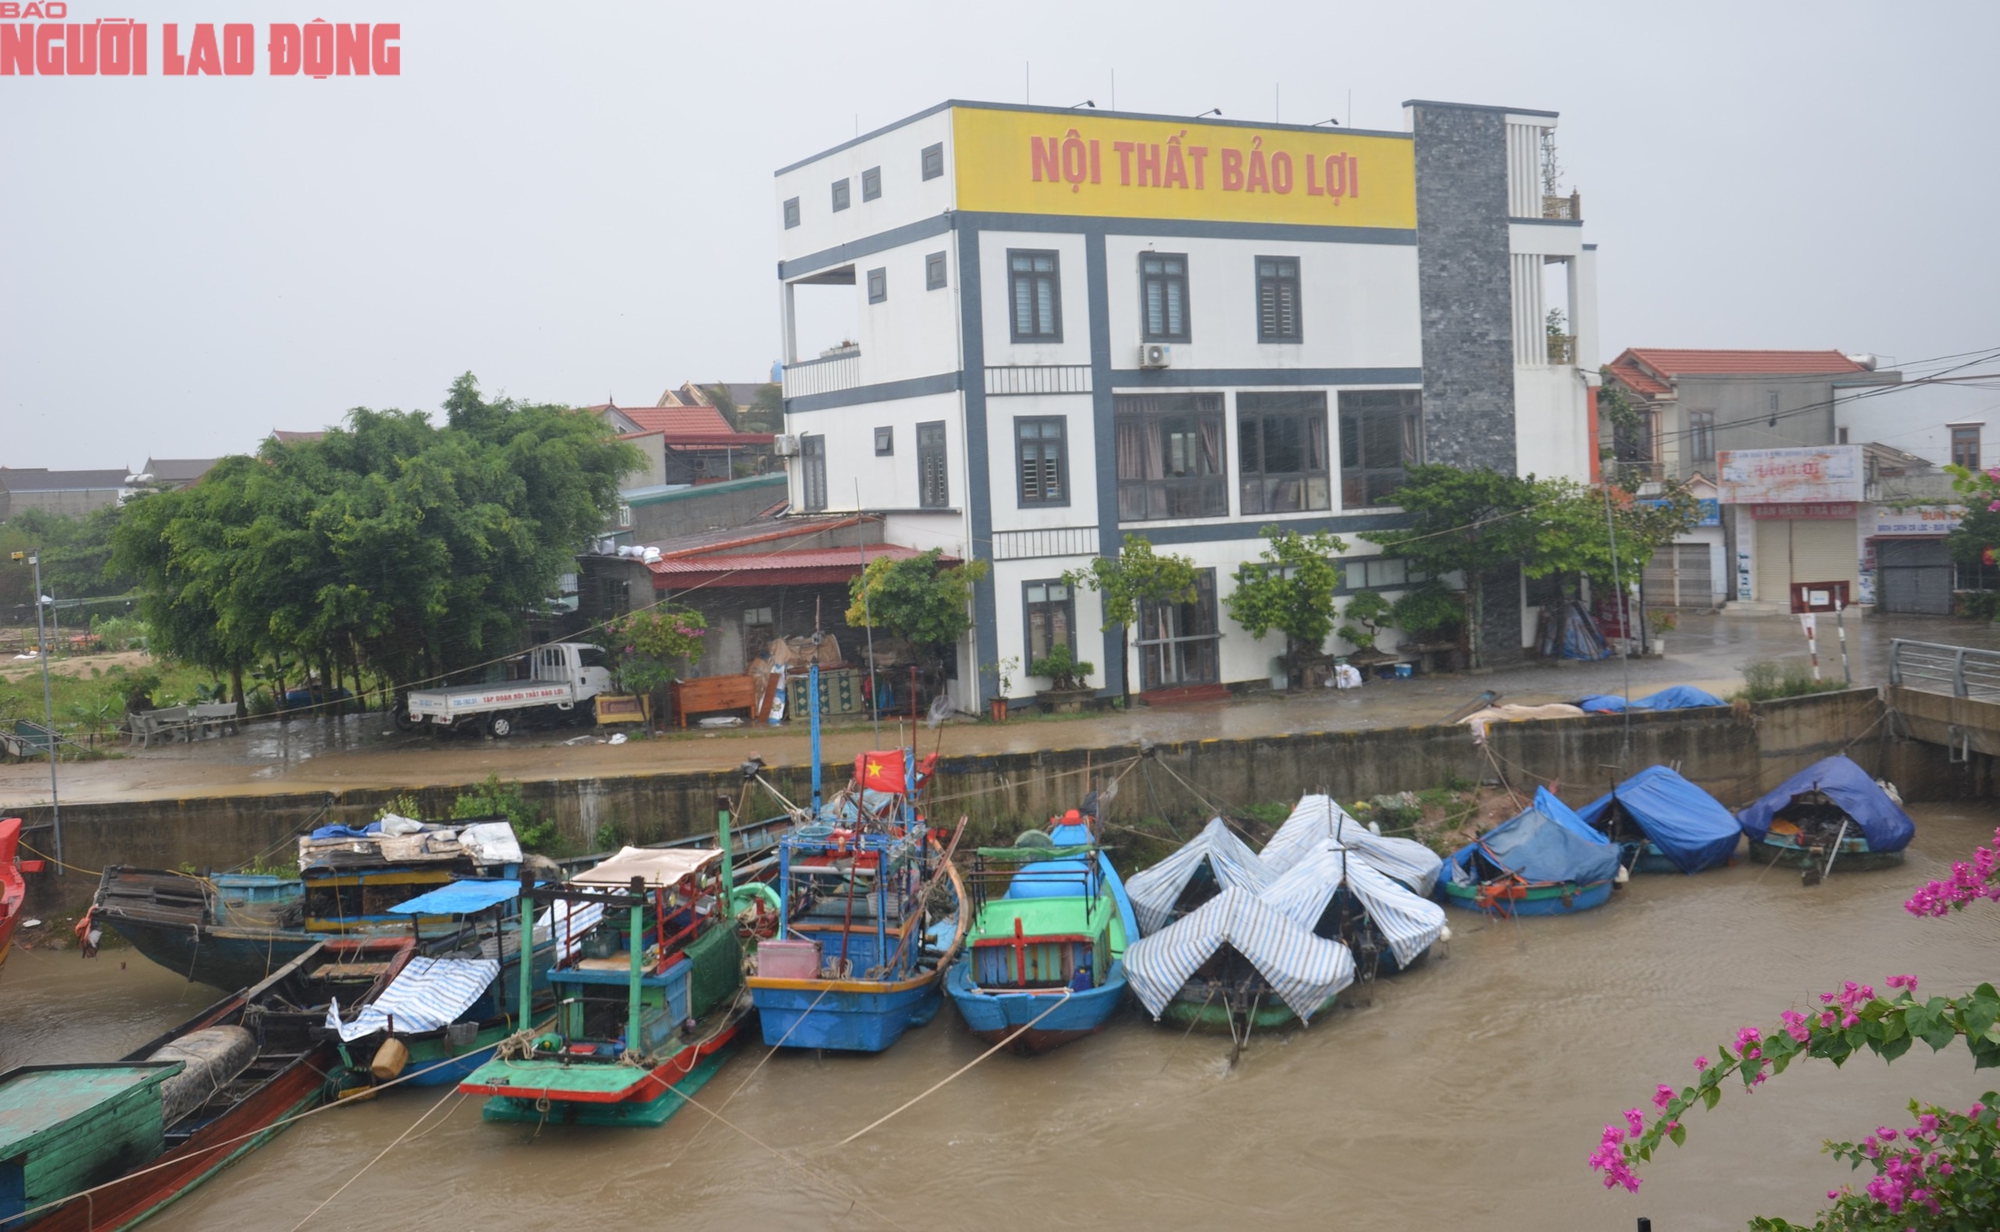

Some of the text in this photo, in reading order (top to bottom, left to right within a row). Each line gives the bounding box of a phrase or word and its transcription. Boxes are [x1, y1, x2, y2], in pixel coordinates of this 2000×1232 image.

[1030, 128, 1358, 206] NỘI THẤT BẢO LỢI
